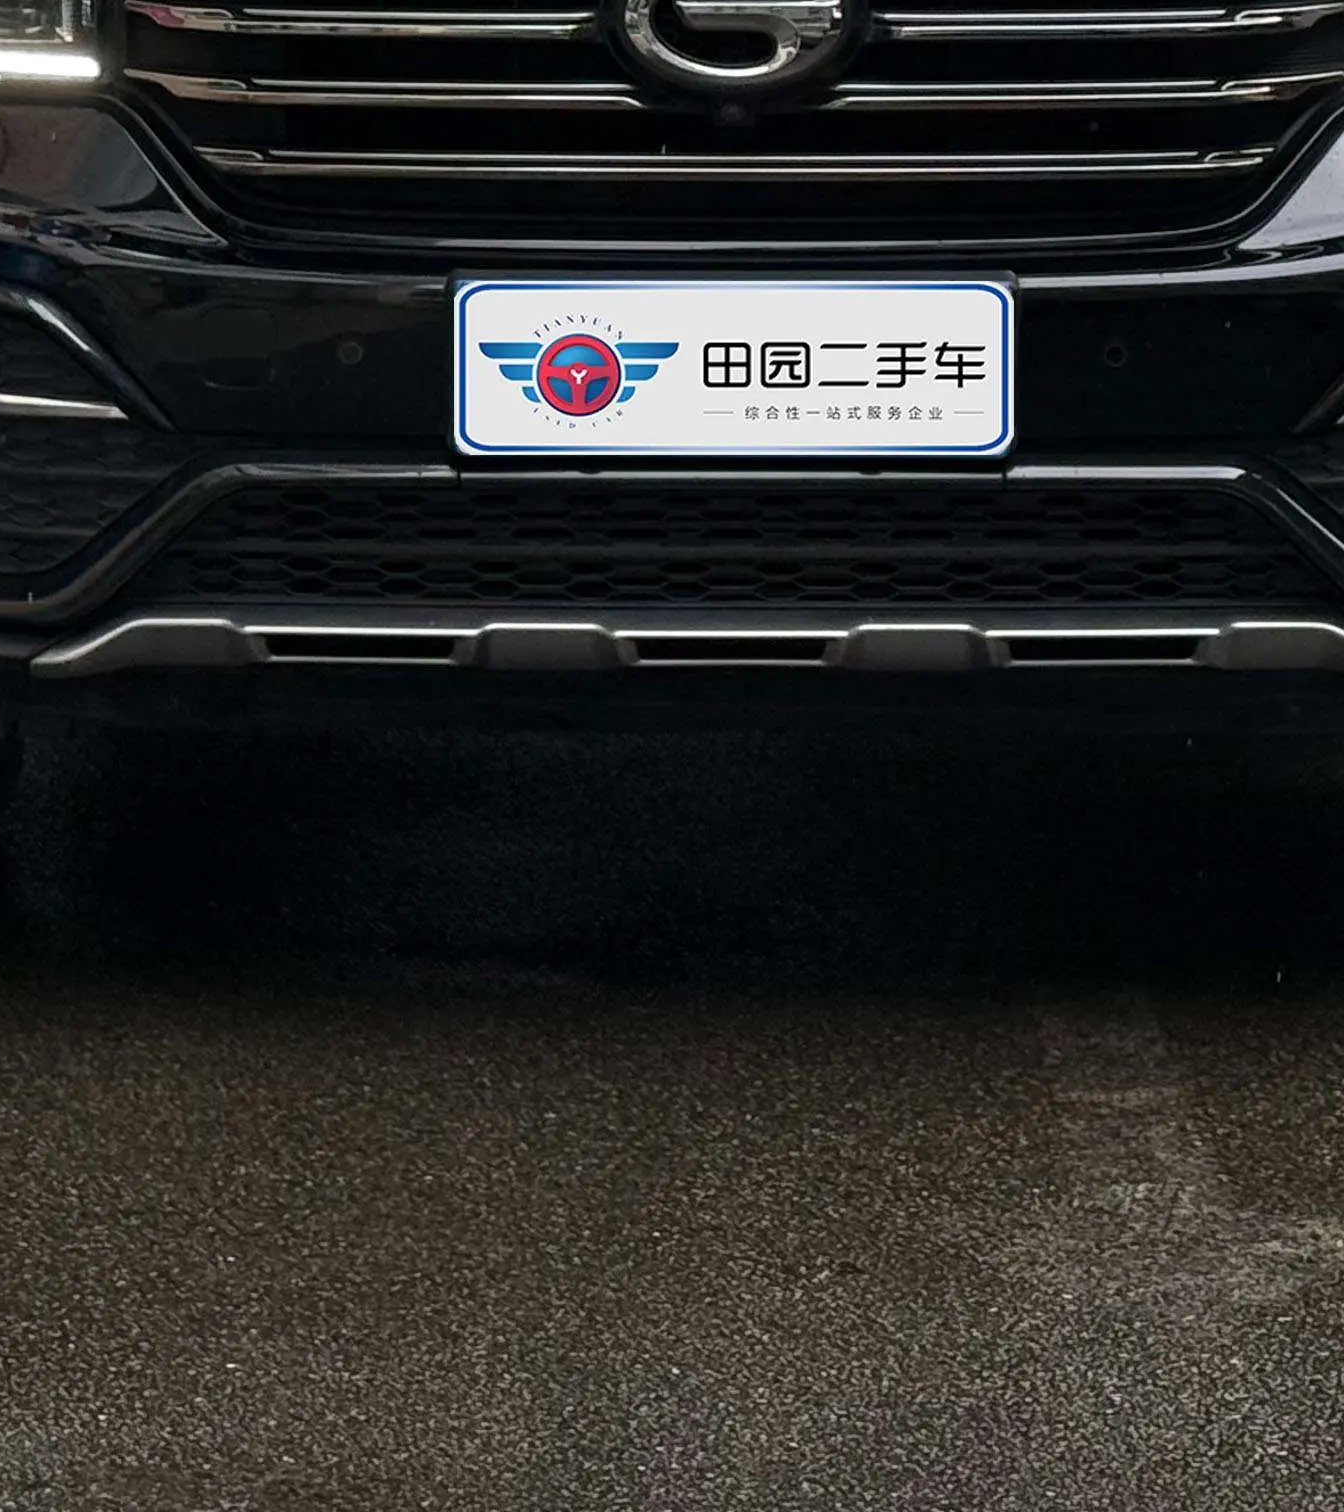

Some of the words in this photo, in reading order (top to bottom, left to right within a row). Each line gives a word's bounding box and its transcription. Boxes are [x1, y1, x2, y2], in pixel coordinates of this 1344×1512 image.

[703, 341, 986, 389] 田园二手车
[743, 405, 944, 421] 综合性一站式服务企业
